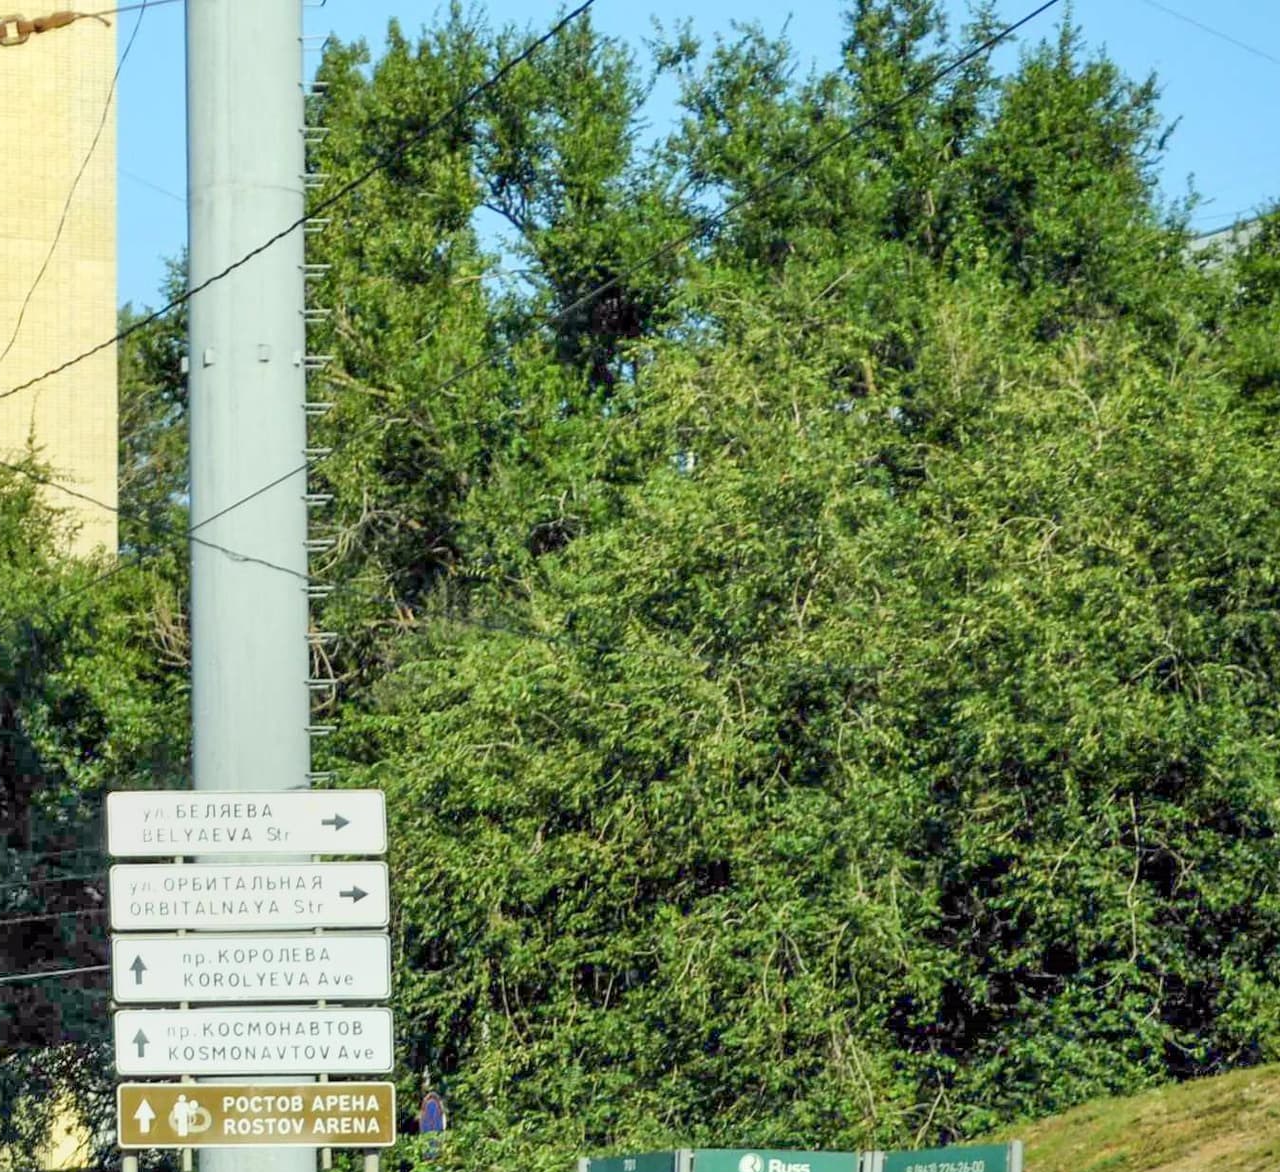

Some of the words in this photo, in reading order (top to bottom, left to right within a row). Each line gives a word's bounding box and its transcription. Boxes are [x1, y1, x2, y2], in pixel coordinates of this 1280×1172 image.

[176, 804, 273, 819] БЕЛЯЕВА
[143, 827, 253, 843] BELYAEVA
[267, 827, 291, 841] Str
[163, 875, 323, 892] ОРБИТАЛЬНАЯ
[130, 900, 280, 916] ORBITALNAYA
[294, 900, 324, 914] Str
[182, 953, 212, 967] пр.
[218, 948, 330, 964] КОРОЛЕВА
[184, 972, 309, 987] KOROLYEVA
[318, 972, 354, 986] Ave
[167, 1026, 197, 1040] пр.
[203, 1021, 364, 1037] КОСМОНАВТОВ
[168, 1045, 330, 1061] KOSMONAVTOV
[338, 1045, 374, 1060] Ave
[223, 1095, 304, 1113] РОСТОВ
[312, 1095, 380, 1112] АРЕНА
[223, 1117, 305, 1134] ROSTOV
[312, 1117, 380, 1134] ARENA
